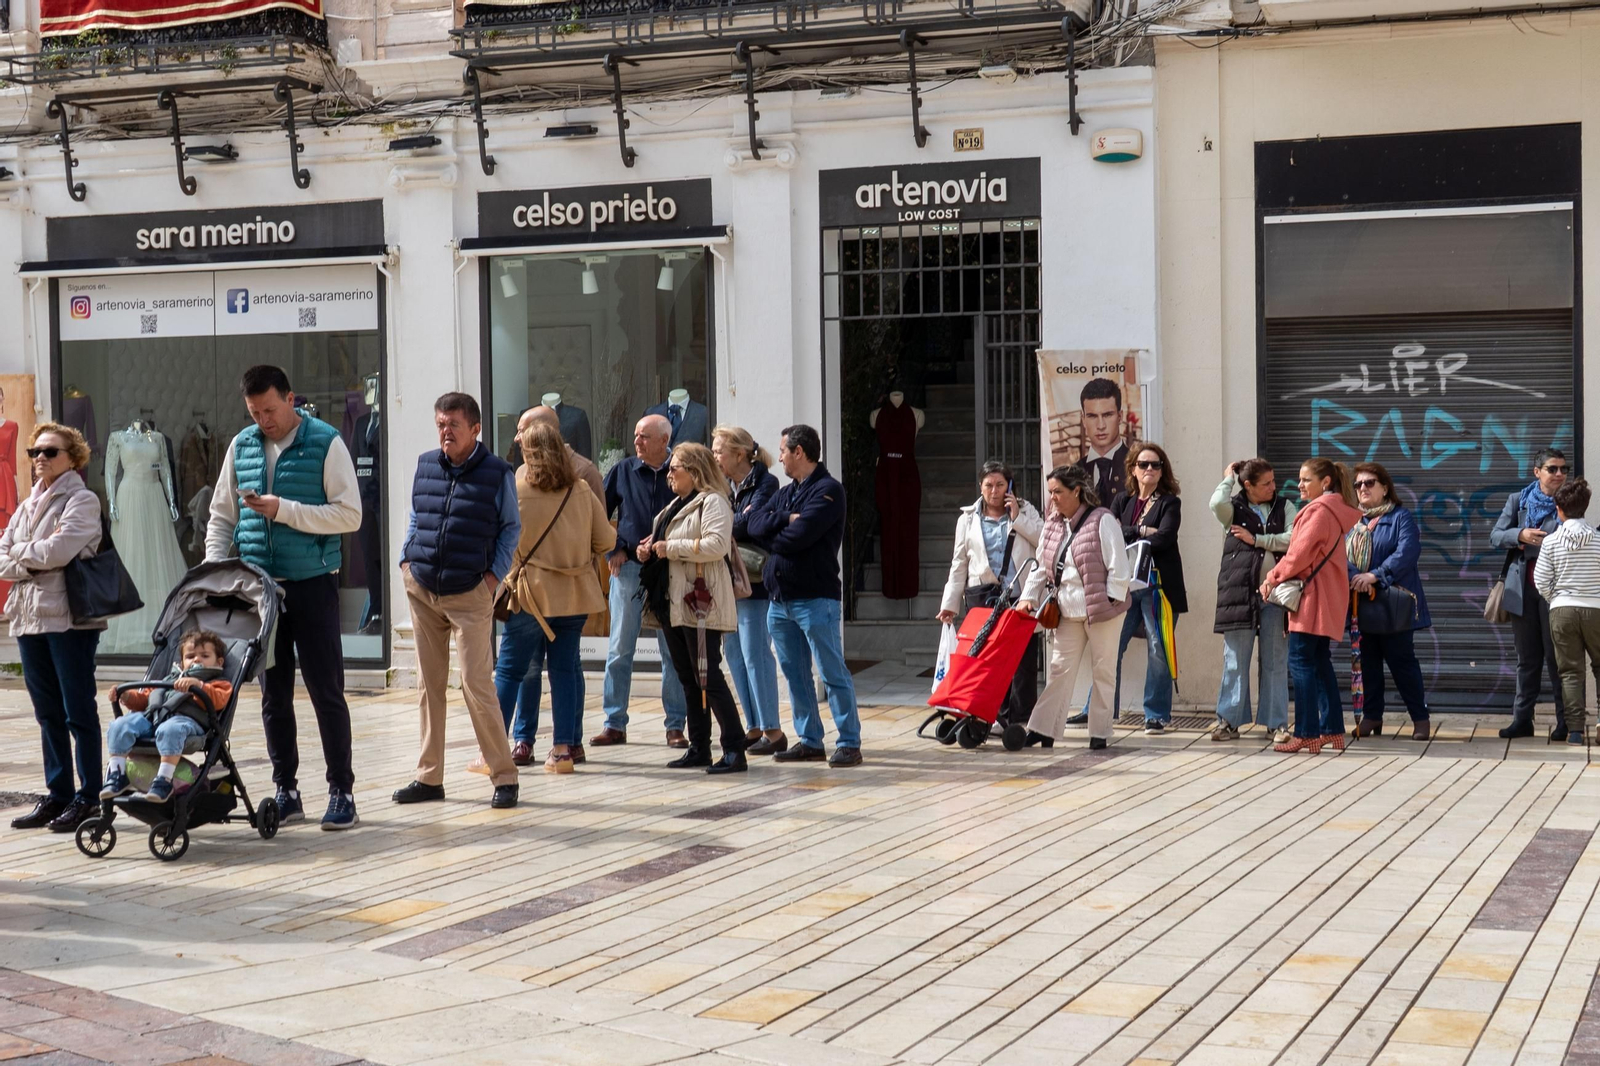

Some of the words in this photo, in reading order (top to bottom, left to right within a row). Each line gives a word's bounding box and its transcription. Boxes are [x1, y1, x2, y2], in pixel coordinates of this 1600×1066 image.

[855, 170, 1007, 208] artenovia
[512, 191, 584, 228] celso
[590, 186, 677, 232] prieto
[898, 211, 925, 222] LOW
[928, 208, 960, 220] COST
[136, 225, 196, 250] sara
[201, 215, 295, 247] merino
[96, 296, 214, 313] artenovia_saramerino
[252, 288, 374, 305] artenovia-saramerino
[1056, 361, 1087, 374] celso
[1091, 361, 1126, 376] prieto
